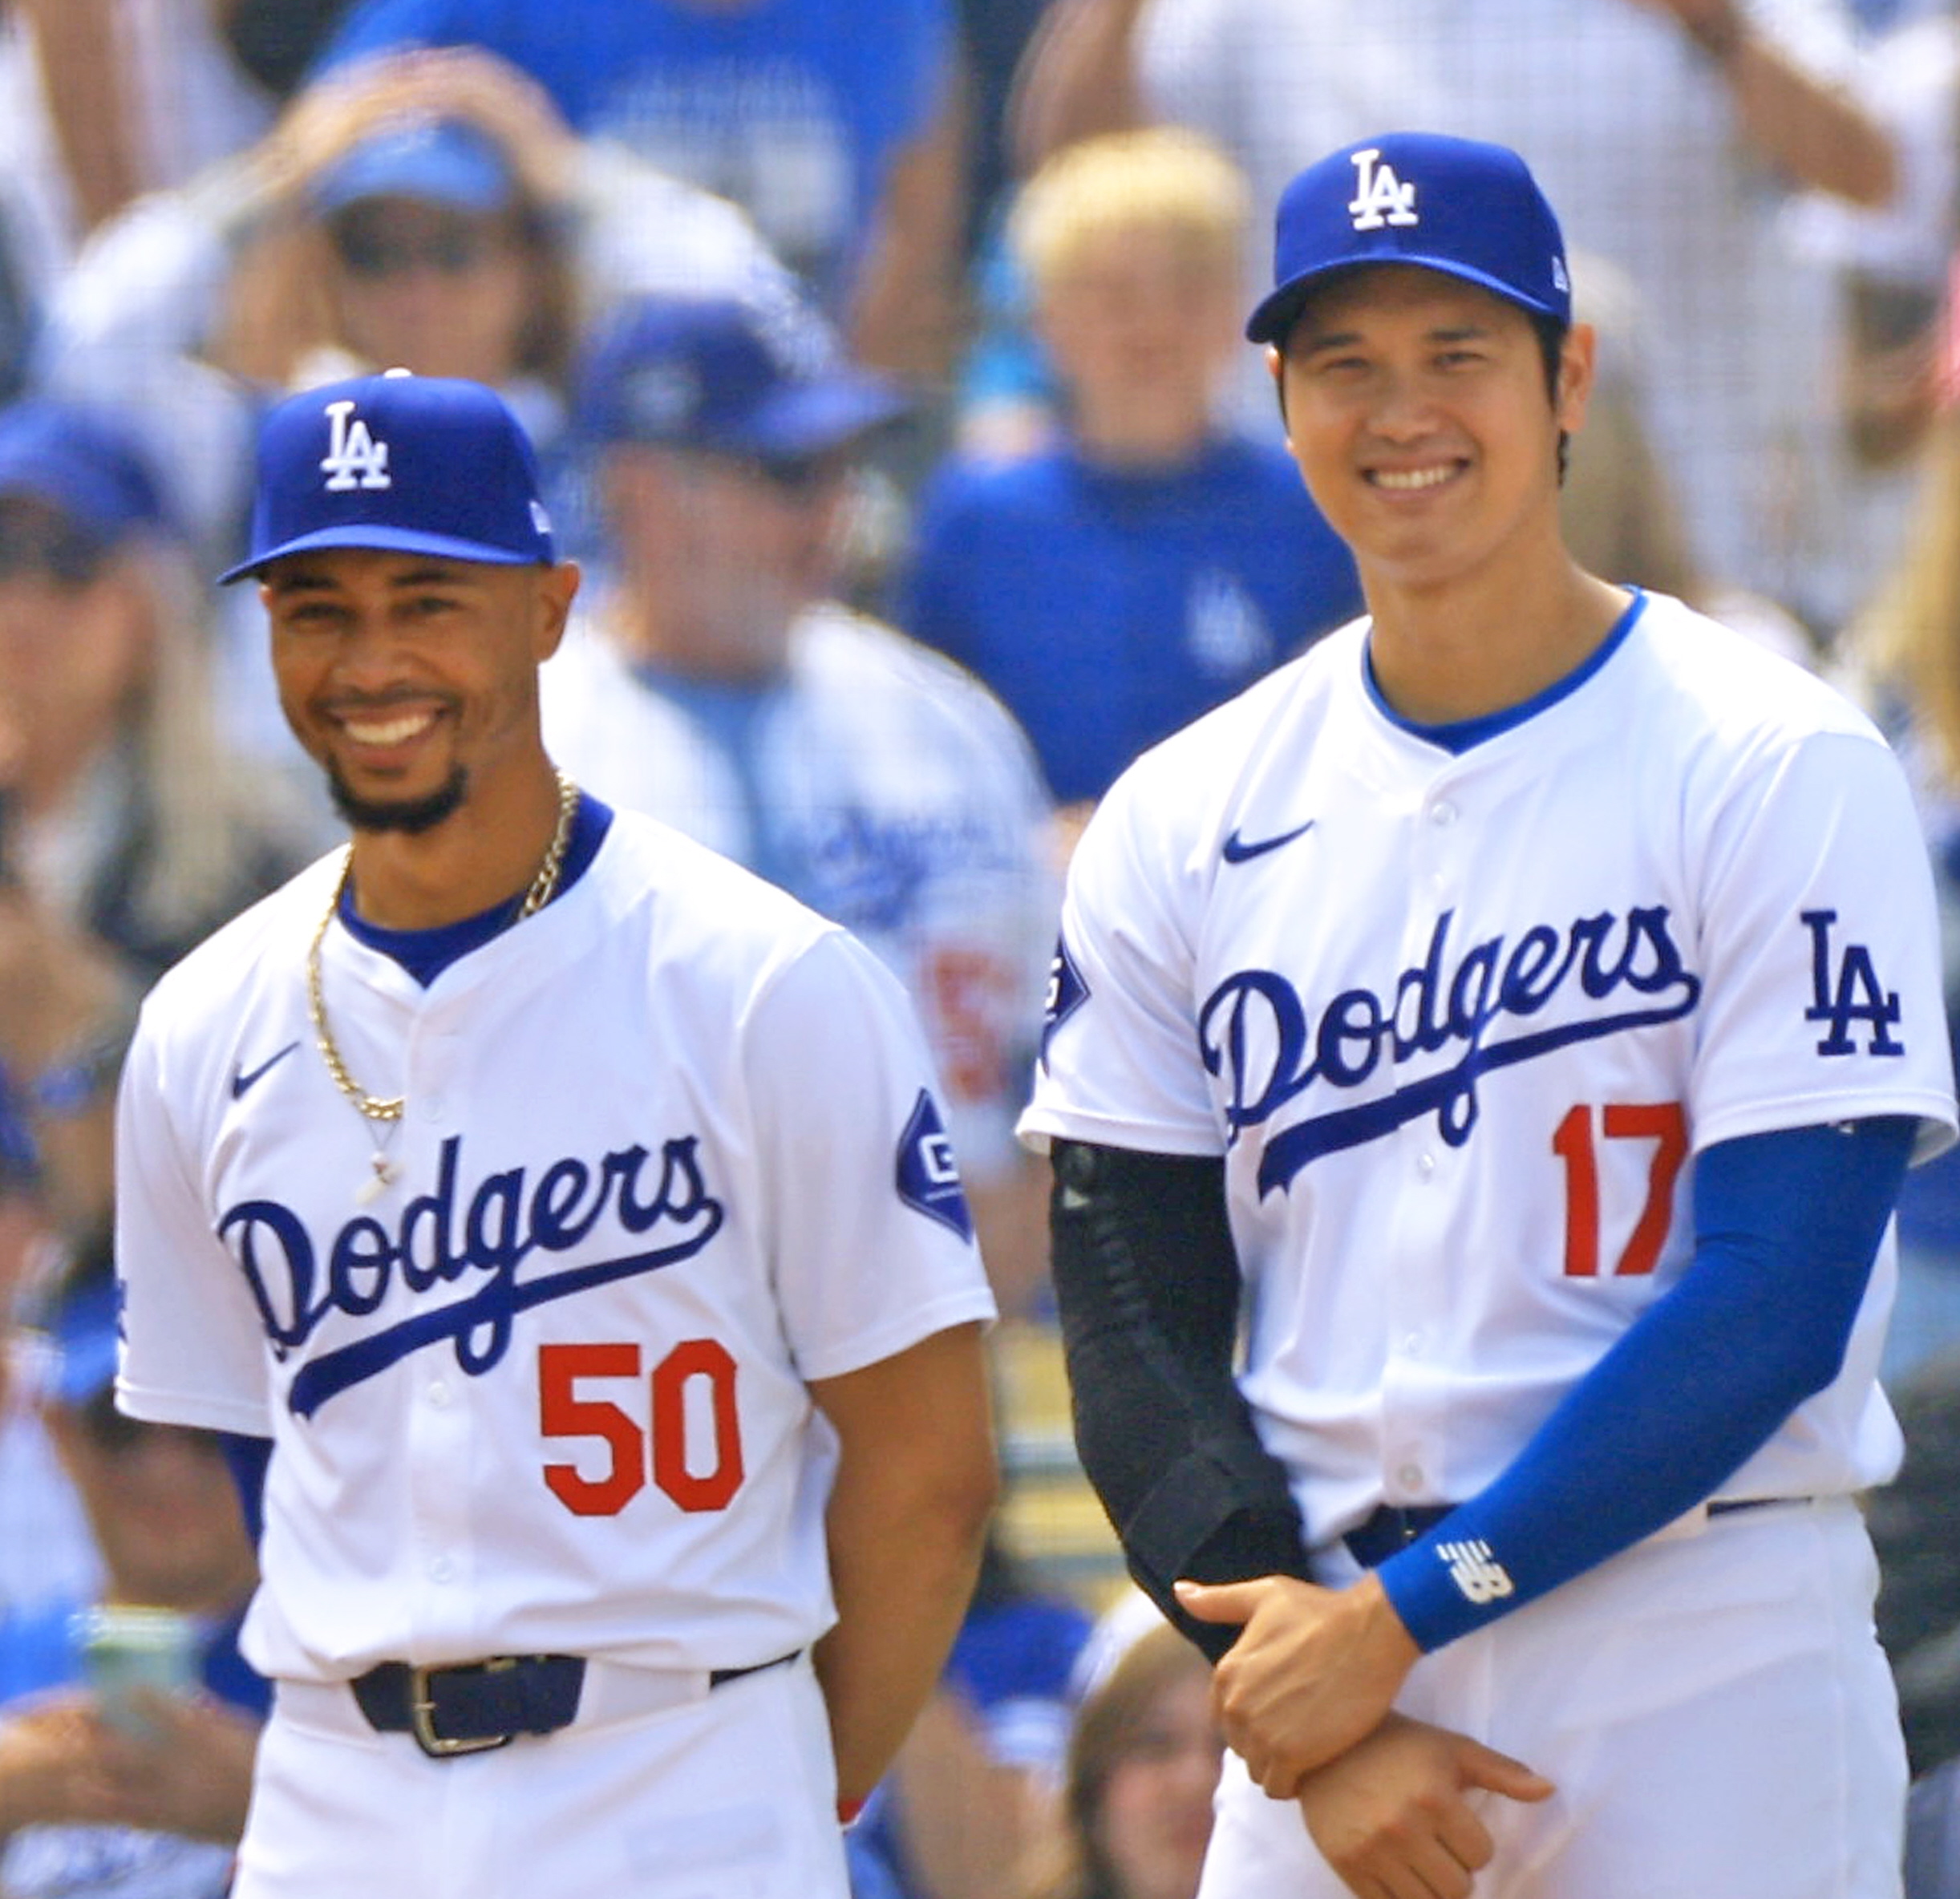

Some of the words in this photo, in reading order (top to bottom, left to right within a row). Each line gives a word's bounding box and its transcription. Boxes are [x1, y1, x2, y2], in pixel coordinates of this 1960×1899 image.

[1348, 148, 1419, 231] LA
[320, 399, 391, 492] LA
[1197, 905, 1703, 1203] Dodgers
[1800, 909, 1905, 1057] LA
[217, 1135, 726, 1421] Dodgers
[1553, 1101, 1690, 1278] 17
[538, 1338, 745, 1516] 50
